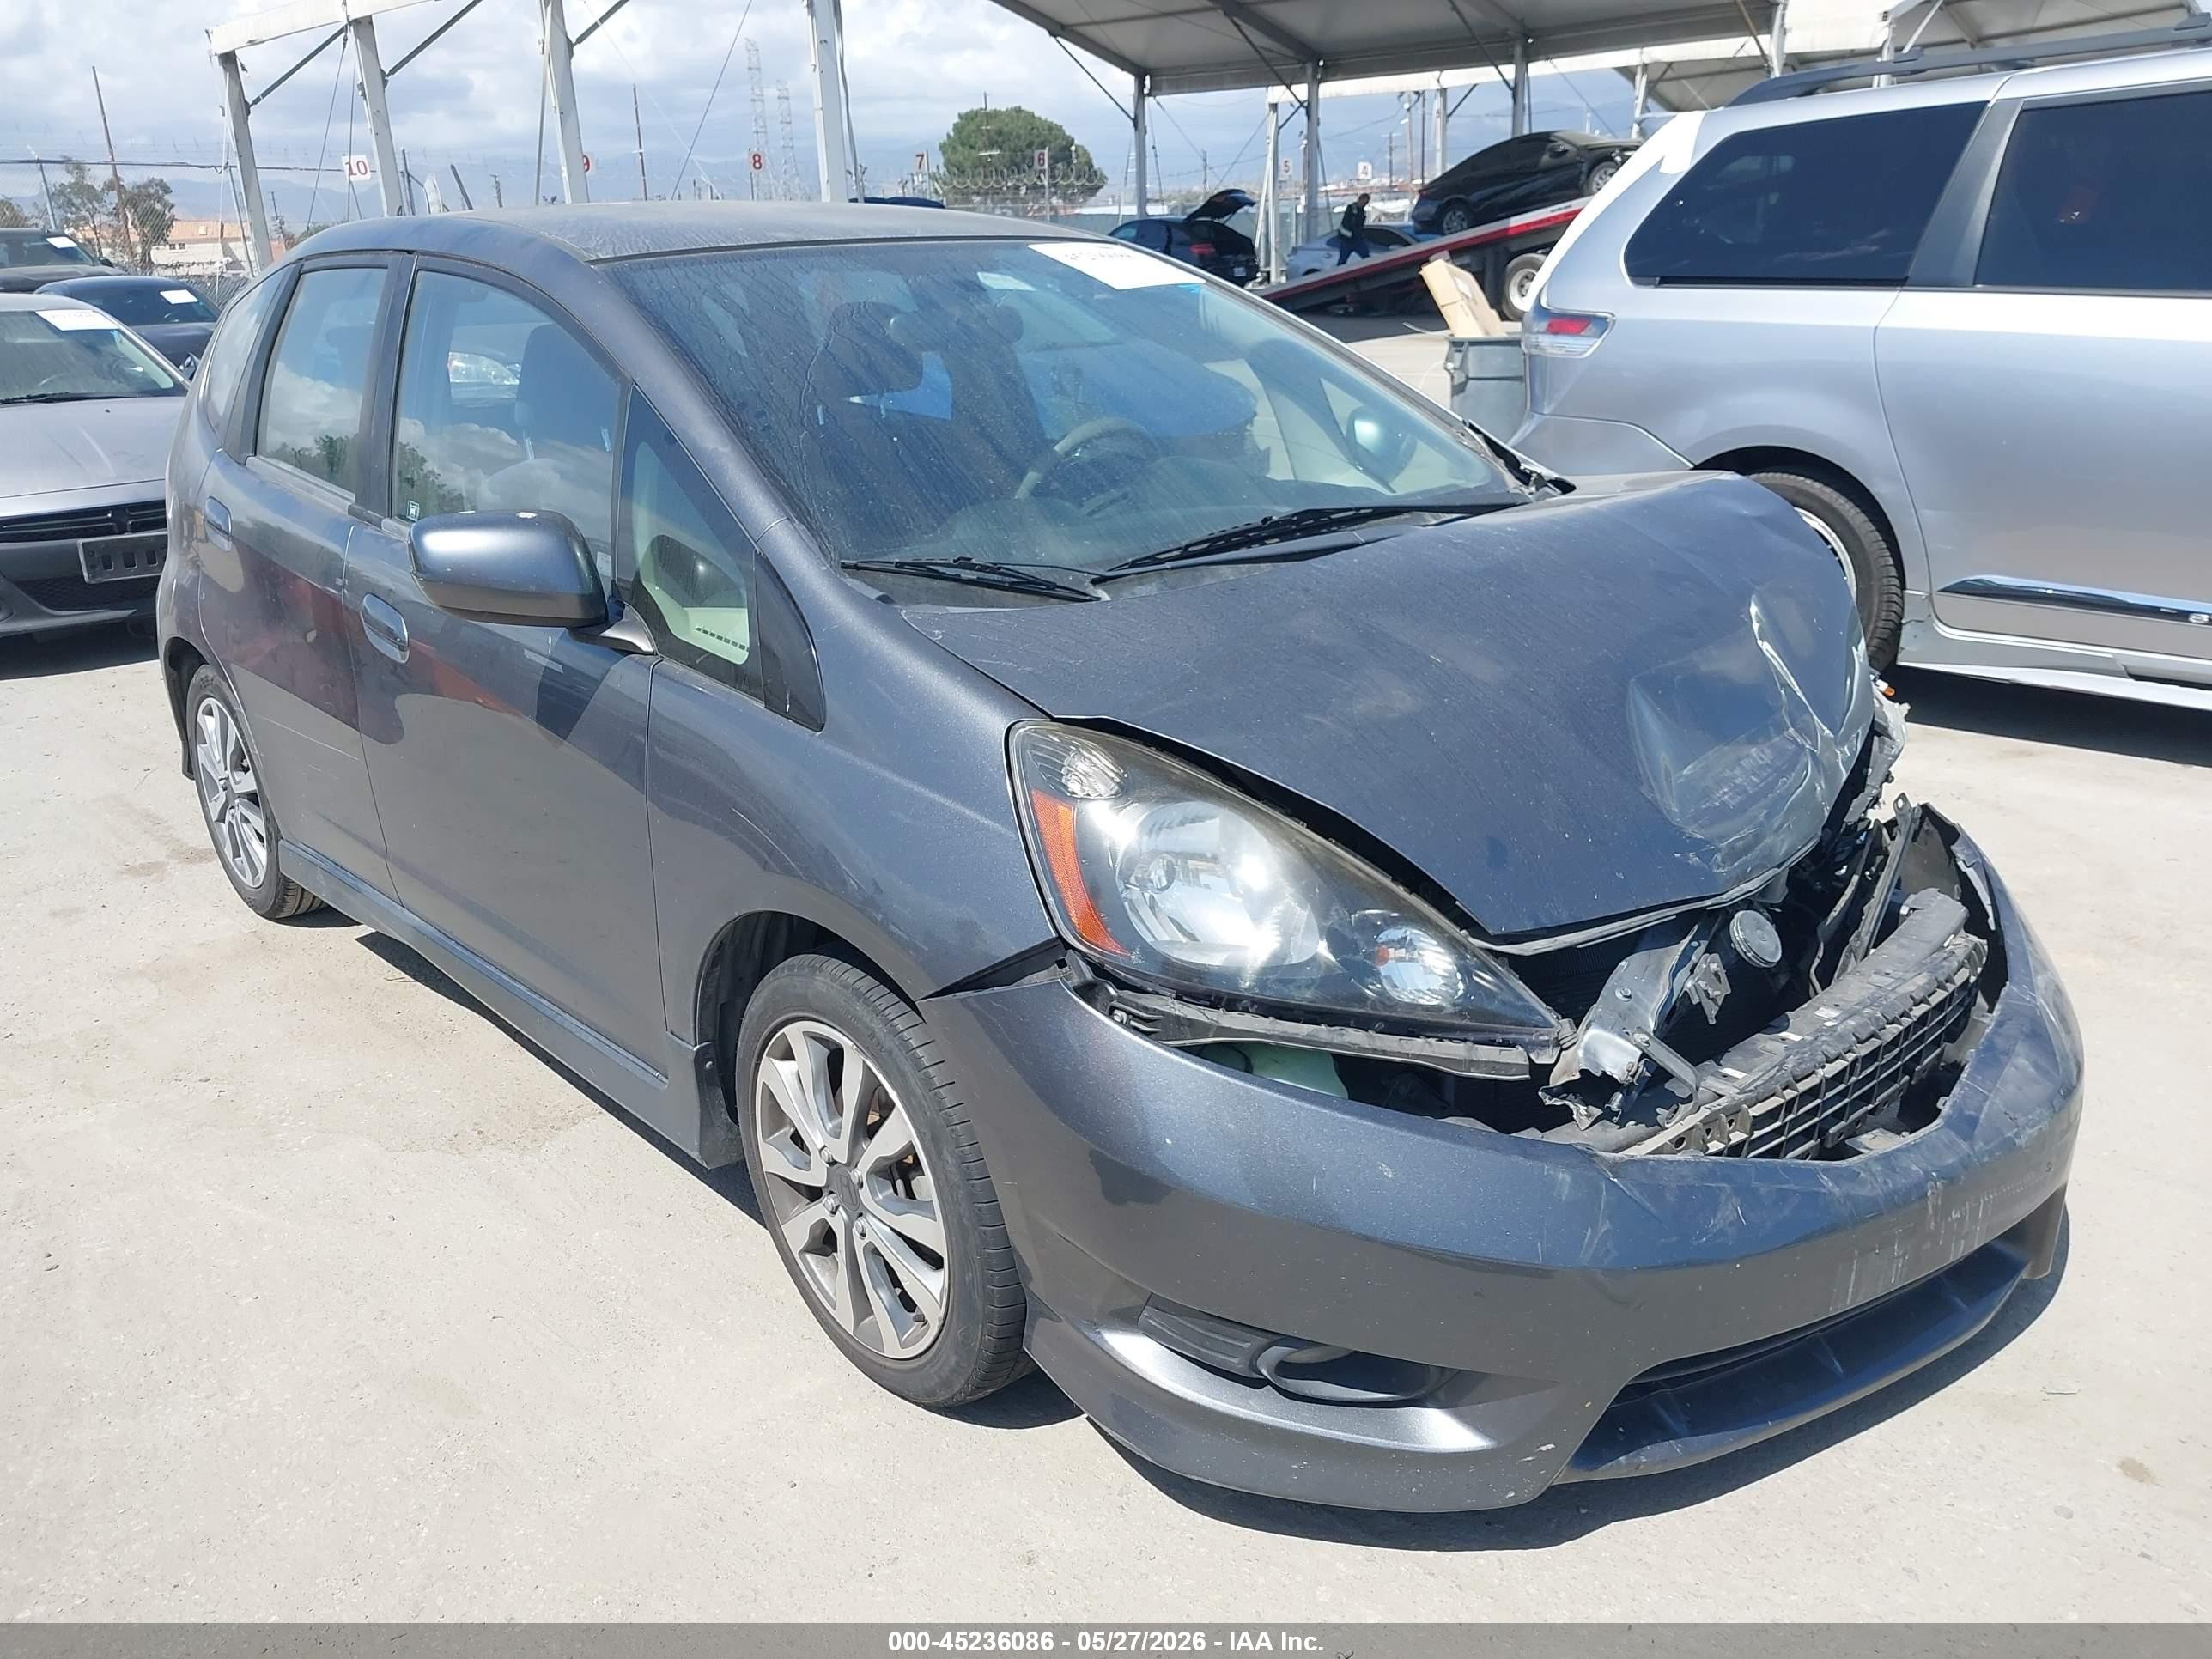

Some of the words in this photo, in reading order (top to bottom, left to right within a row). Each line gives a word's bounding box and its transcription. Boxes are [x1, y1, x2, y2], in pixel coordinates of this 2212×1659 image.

[752, 153, 762, 170] 8
[915, 154, 924, 170] 7
[1038, 152, 1045, 167] 6
[345, 160, 368, 175] 10
